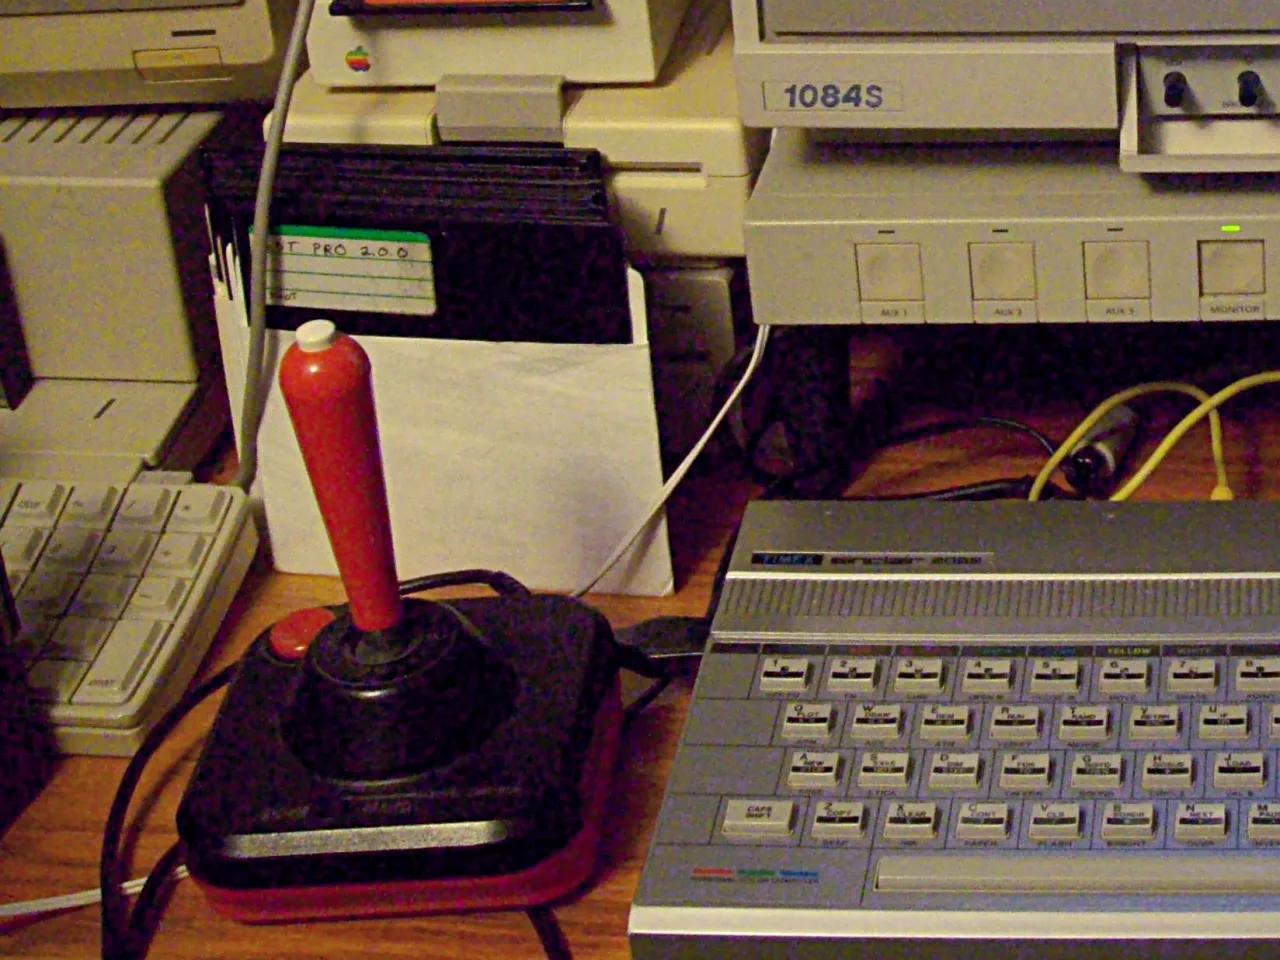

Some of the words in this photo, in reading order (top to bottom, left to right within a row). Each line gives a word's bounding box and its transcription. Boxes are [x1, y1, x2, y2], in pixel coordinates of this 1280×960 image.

[784, 83, 883, 108] 1084S
[312, 243, 347, 257] PRO
[881, 308, 901, 317] AUX
[993, 308, 1012, 317] AUX
[1105, 307, 1125, 316] AUX
[1210, 305, 1260, 314] MONITOR
[763, 553, 815, 564] TIMEX
[1107, 647, 1150, 655] YELLOW
